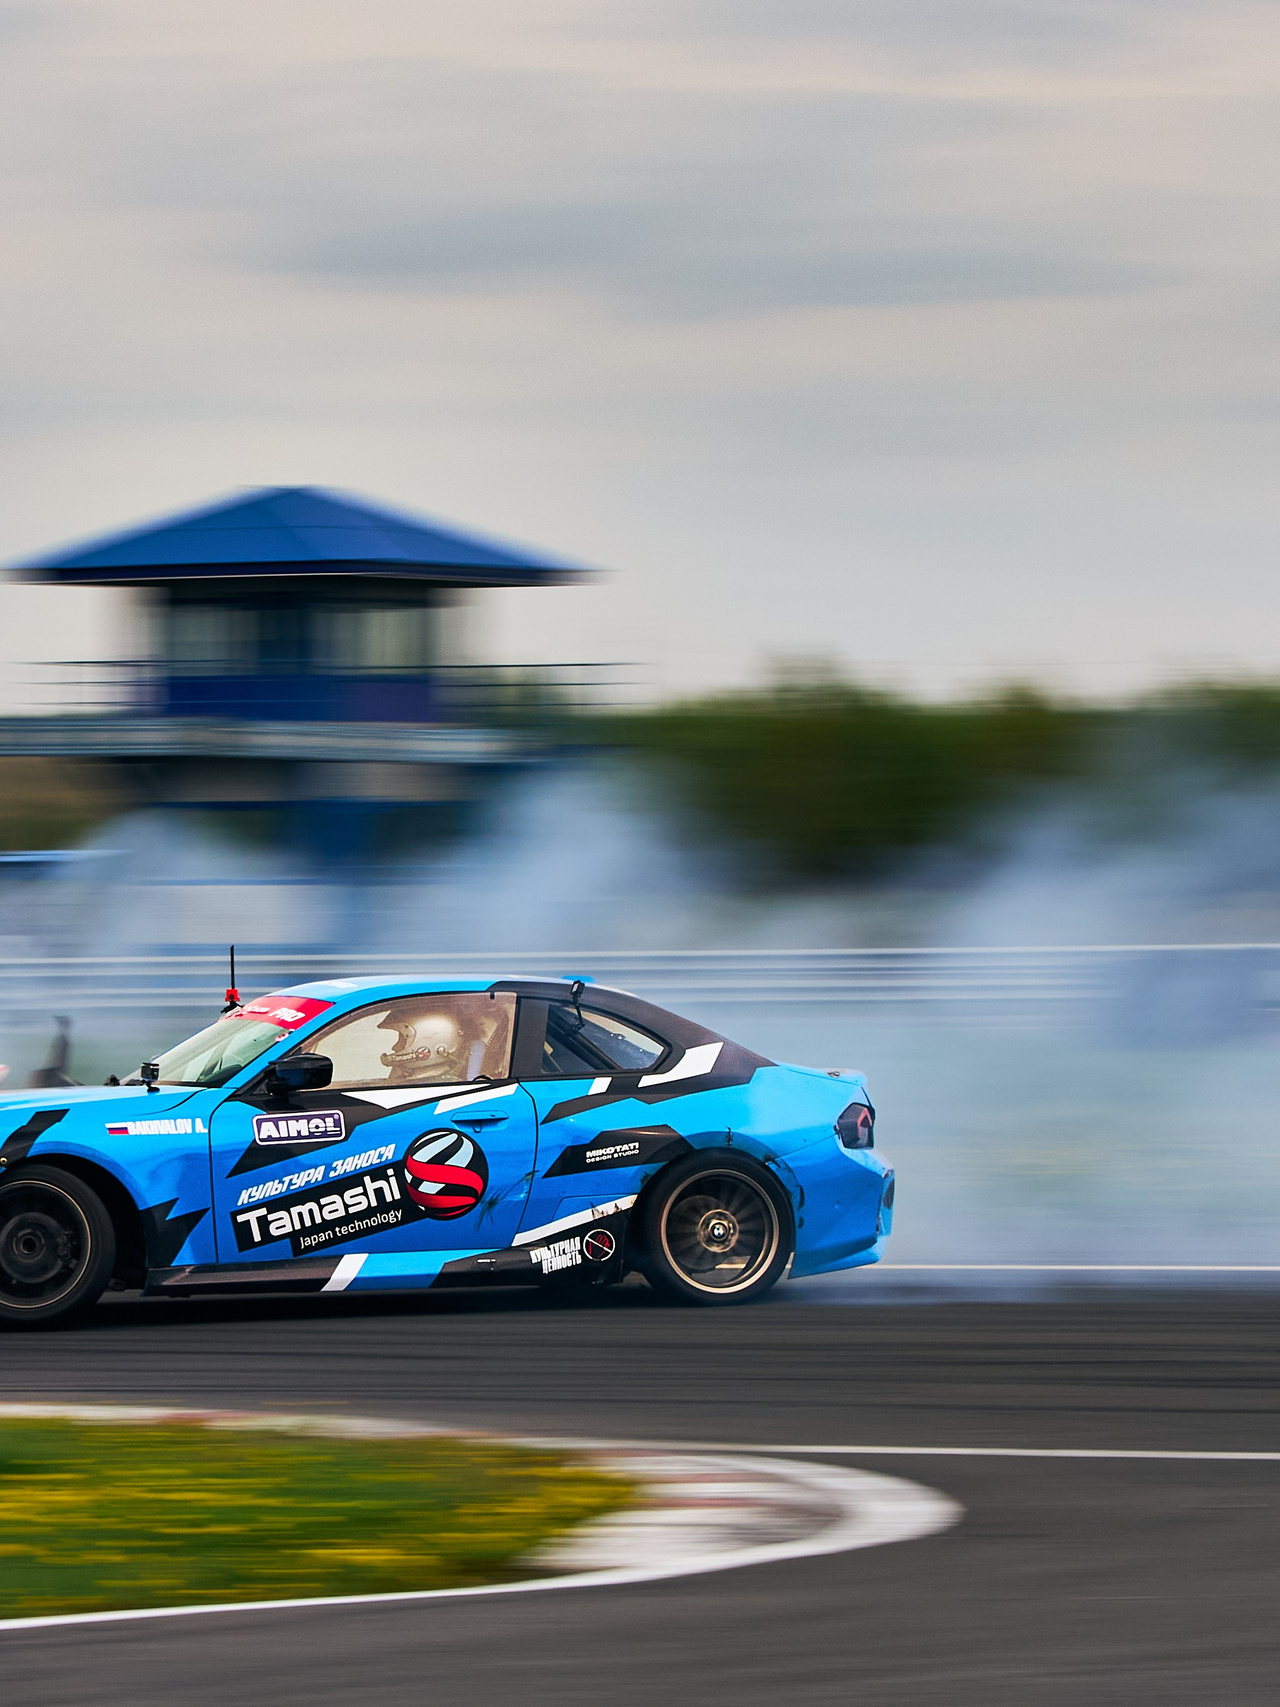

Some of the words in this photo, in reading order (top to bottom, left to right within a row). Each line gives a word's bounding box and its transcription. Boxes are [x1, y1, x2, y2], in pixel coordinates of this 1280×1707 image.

[269, 1007, 306, 1022] PRO
[127, 1119, 192, 1136] BAKHVALOV
[260, 1117, 341, 1139] AIMOL
[586, 1142, 639, 1158] MIKOTATI
[613, 1149, 639, 1158] STUDIO
[237, 1165, 326, 1206] КУЛЬТУРА
[329, 1143, 396, 1178] ЗАНОСА
[237, 1168, 401, 1243] Tamashi
[300, 1230, 333, 1249] Japan
[335, 1209, 403, 1237] technology
[529, 1236, 581, 1264] КУЛЬТУРНАЯ
[542, 1251, 582, 1274] ЦЕННОСТЬ
